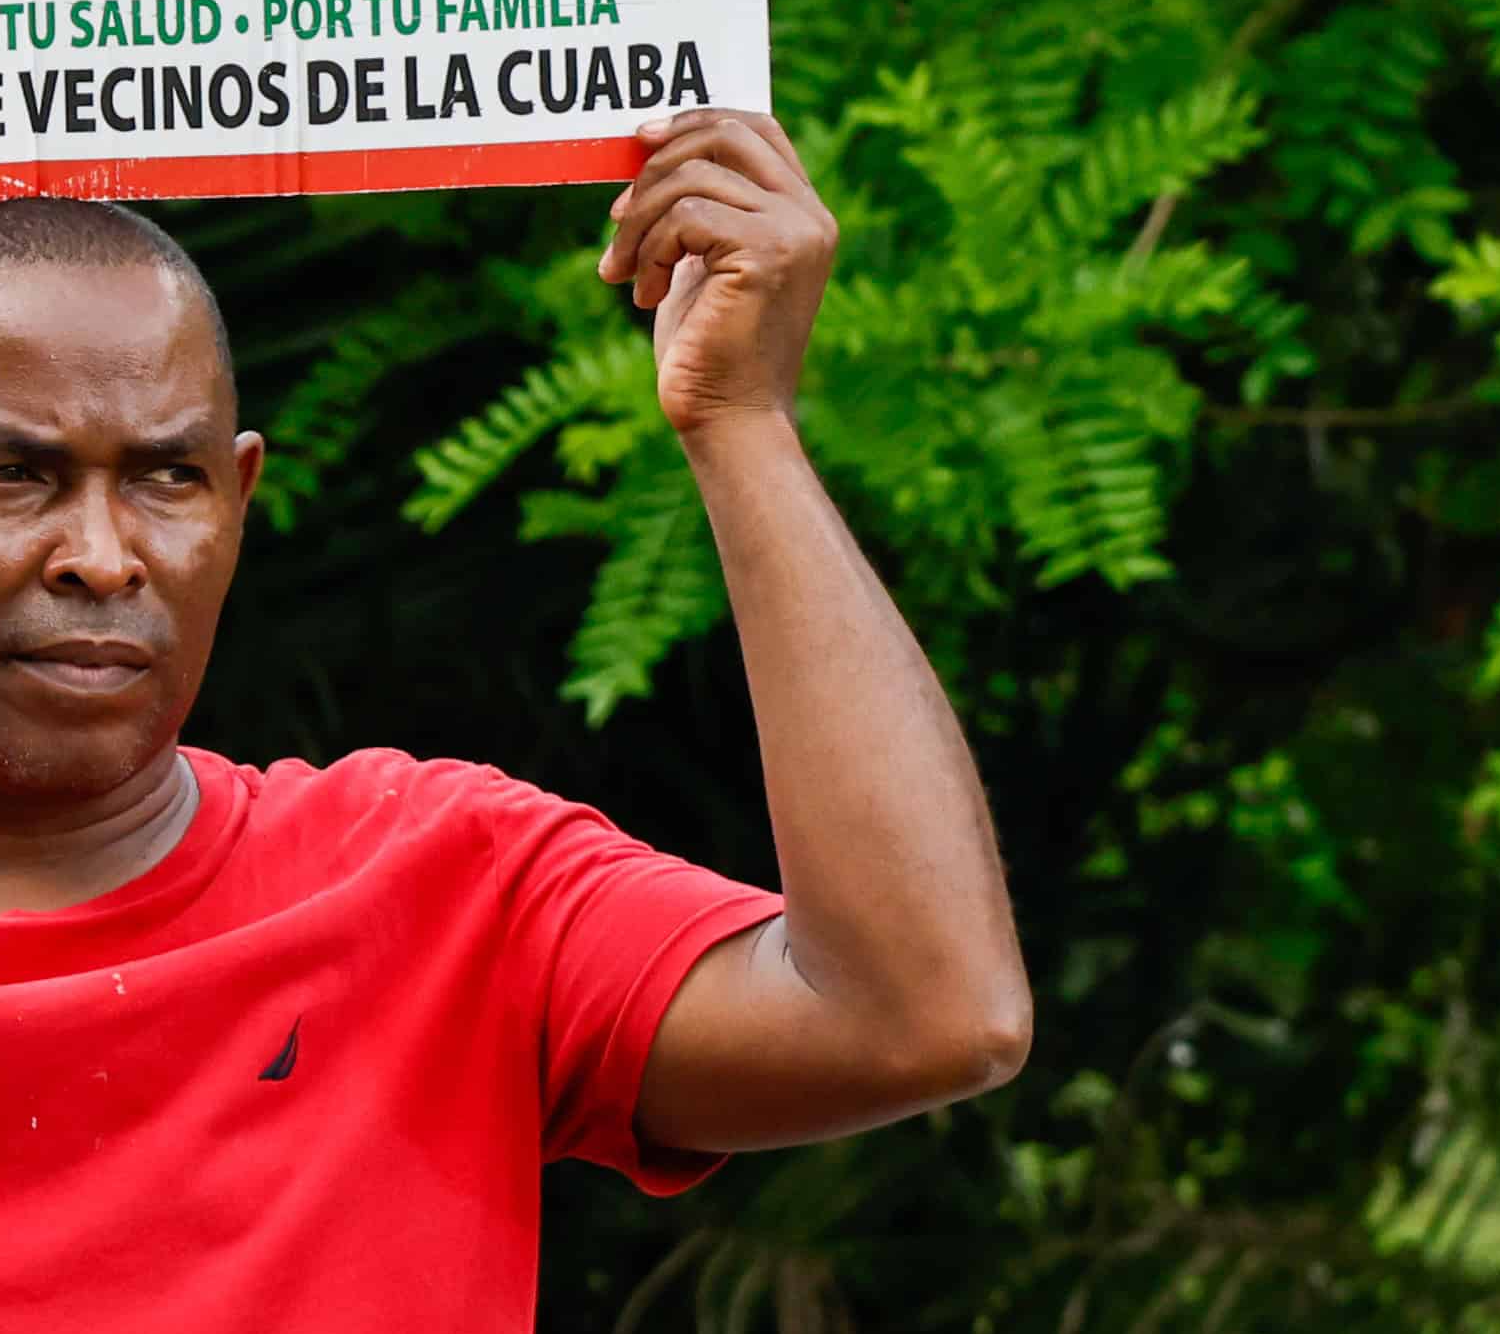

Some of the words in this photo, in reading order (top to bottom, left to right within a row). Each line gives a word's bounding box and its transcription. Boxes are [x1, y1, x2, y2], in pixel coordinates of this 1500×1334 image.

[17, 61, 291, 135] VECINOS
[306, 58, 389, 126] DE
[403, 53, 482, 122] LA
[496, 41, 711, 117] CUABA
